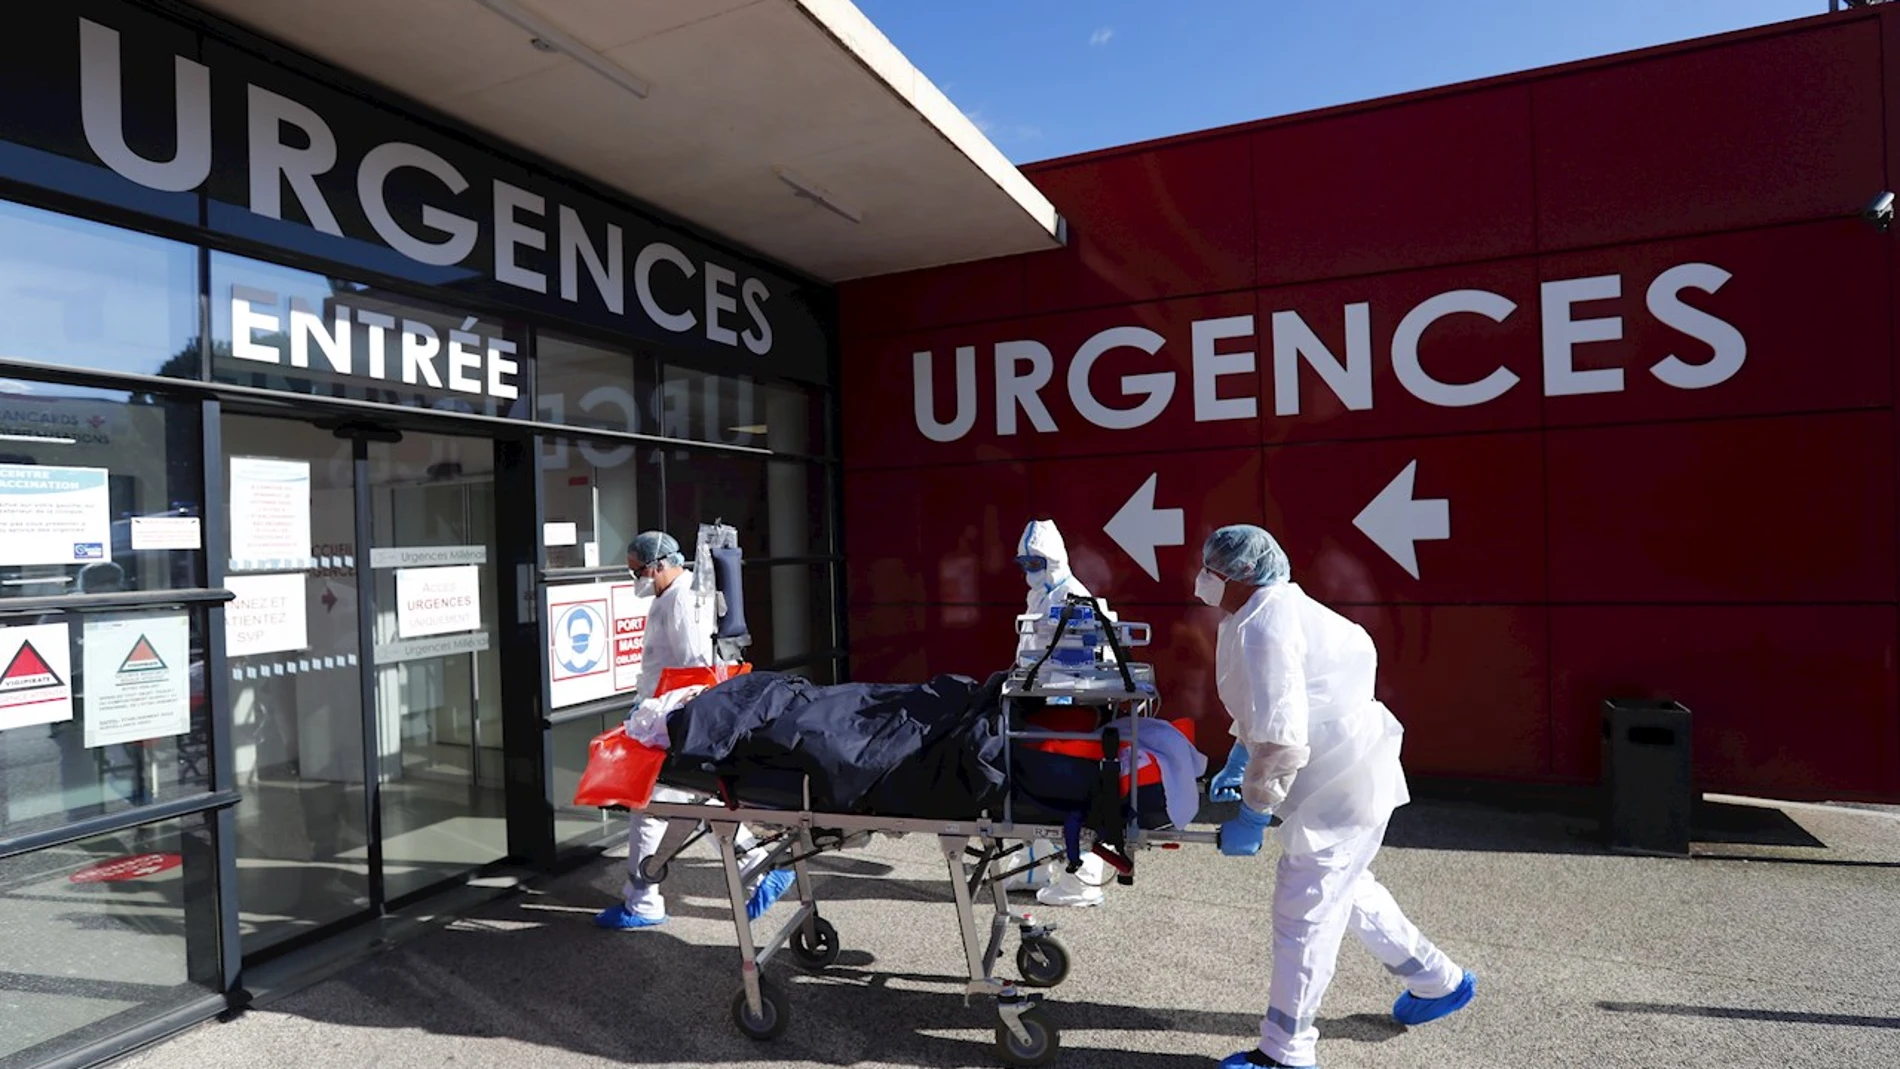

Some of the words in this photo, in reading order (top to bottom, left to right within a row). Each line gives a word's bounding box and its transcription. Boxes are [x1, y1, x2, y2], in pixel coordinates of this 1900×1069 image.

[79, 17, 773, 355] URGENCES
[231, 283, 518, 399] ENTRÉE
[913, 263, 1748, 442] URGENCES
[0, 470, 49, 479] CENTRE
[401, 551, 447, 563] Urgences
[271, 596, 288, 608] ET
[407, 595, 472, 611] URGENCES
[409, 612, 470, 629] UNIQUEMENT
[617, 618, 644, 632] PORT
[236, 630, 265, 643] SVP
[405, 641, 451, 657] Urgences
